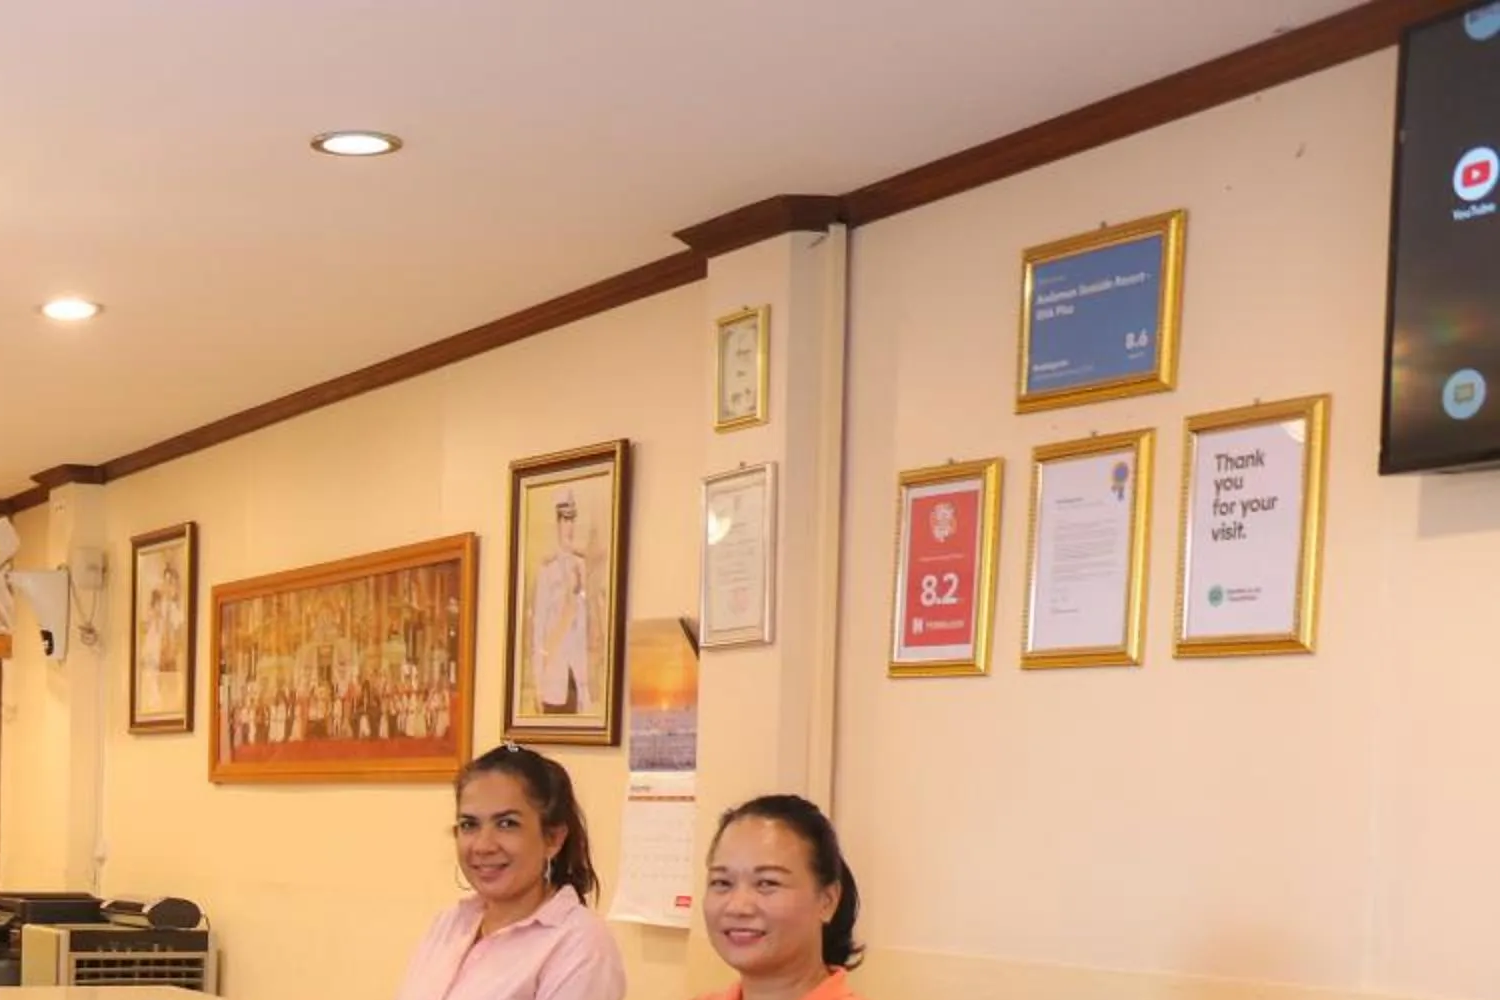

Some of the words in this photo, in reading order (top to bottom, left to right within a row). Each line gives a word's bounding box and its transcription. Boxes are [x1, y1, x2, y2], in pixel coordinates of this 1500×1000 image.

[1453, 202, 1496, 221] YouTube
[1125, 328, 1149, 350] 8.6
[1214, 449, 1266, 472] Thank
[1213, 475, 1244, 496] you
[1212, 498, 1237, 517] for
[1240, 496, 1279, 518] your
[1211, 521, 1247, 541] visit.
[919, 572, 960, 607] 8.2
